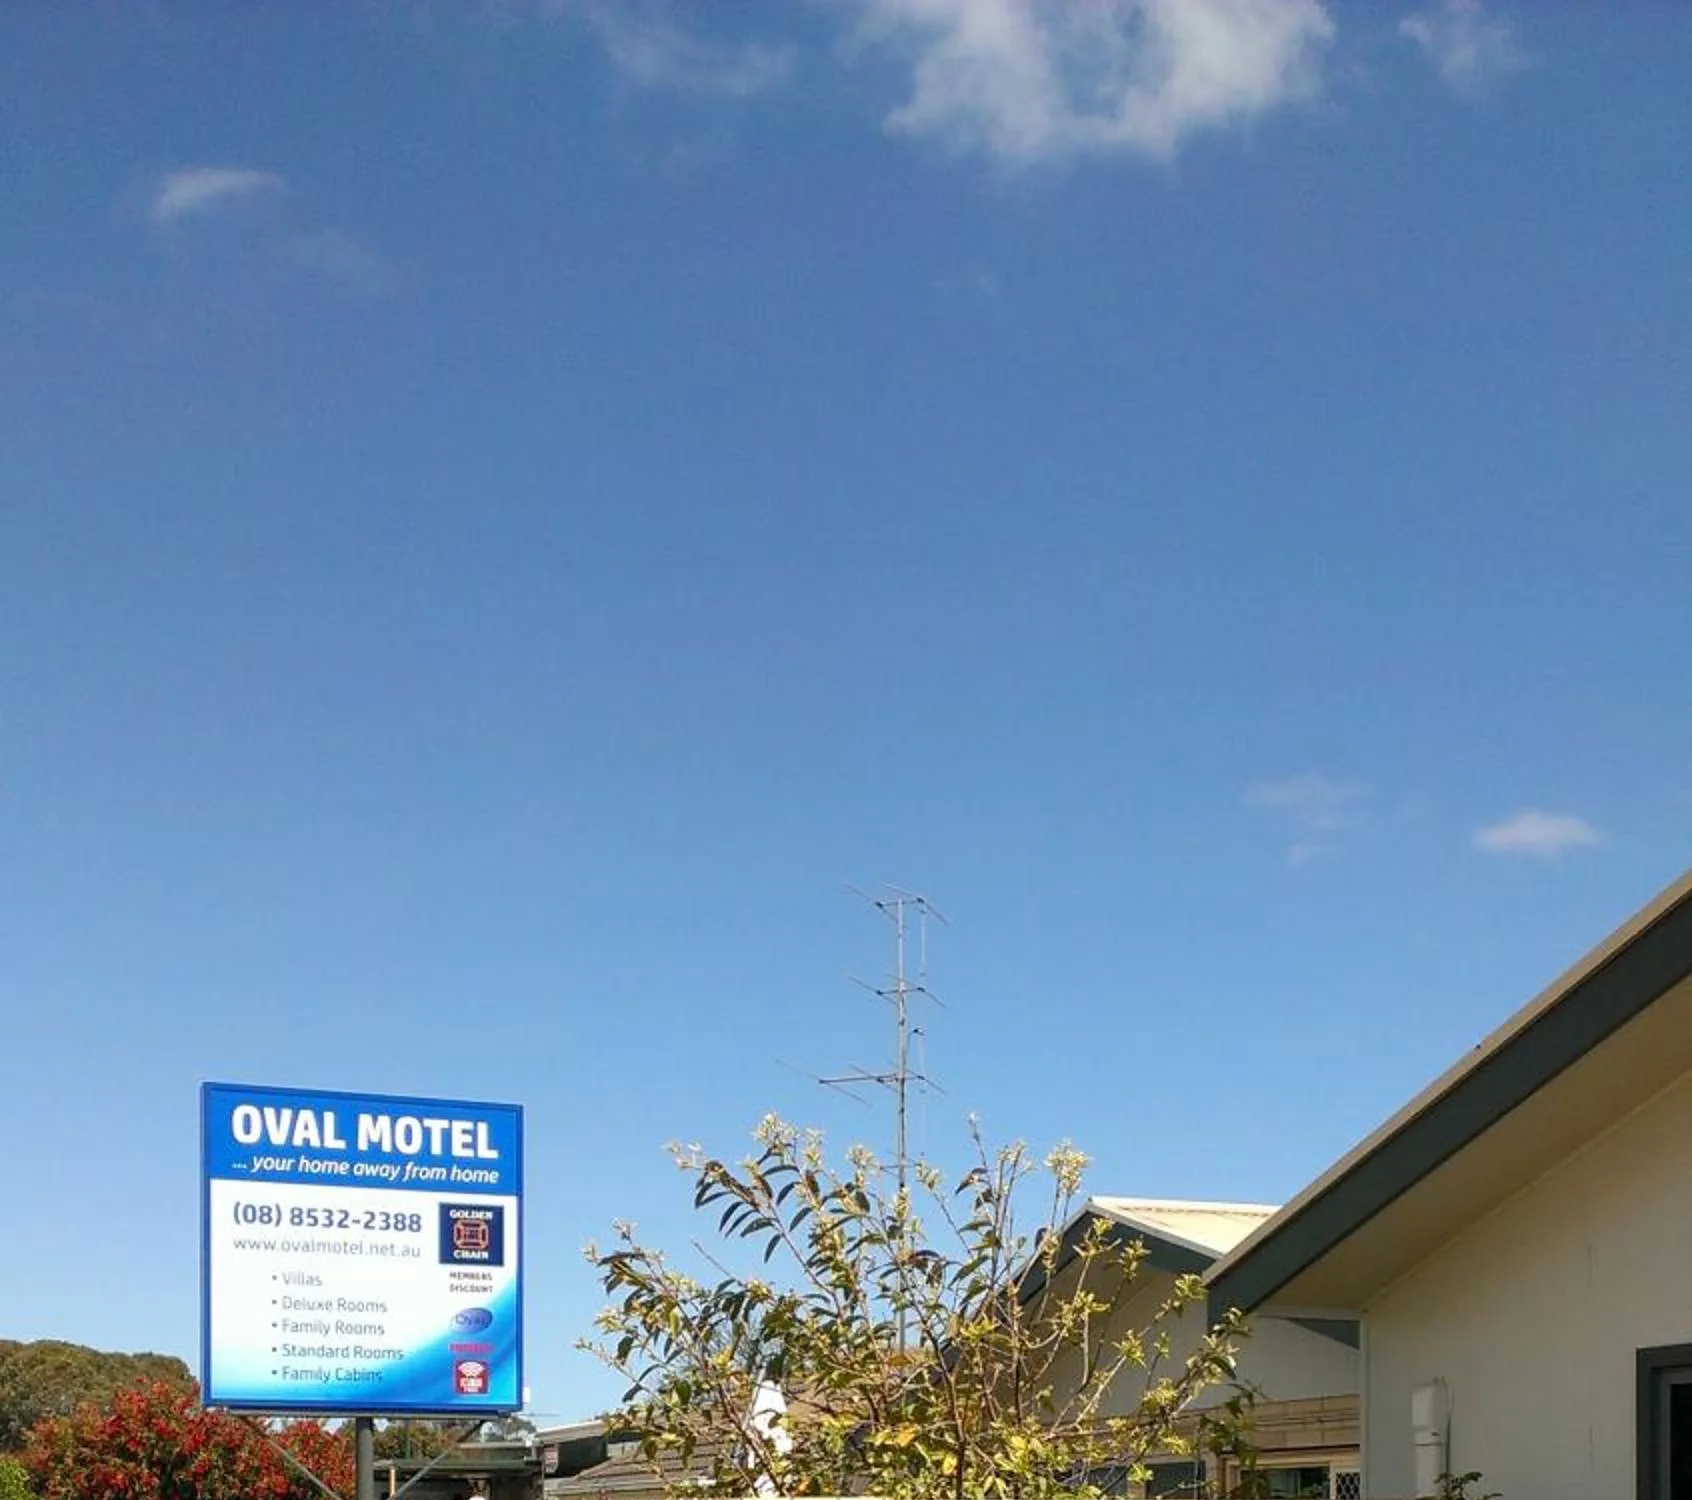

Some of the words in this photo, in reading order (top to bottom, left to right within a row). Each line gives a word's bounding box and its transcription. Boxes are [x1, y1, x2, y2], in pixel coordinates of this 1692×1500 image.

[231, 1104, 346, 1149] OVAL
[357, 1113, 499, 1160] MOTEL
[251, 1155, 297, 1173] your
[298, 1156, 350, 1175] home
[353, 1162, 400, 1182] away
[401, 1162, 447, 1182] from
[451, 1166, 499, 1184] home
[233, 1201, 282, 1227] (08)
[289, 1206, 422, 1233] 8532-2388
[449, 1209, 494, 1219] GOLDEN
[233, 1237, 422, 1258] www.ovalmotel.net.au
[453, 1249, 489, 1260] CHAIN
[282, 1270, 323, 1287] Villas
[449, 1271, 493, 1281] MEMBERS
[282, 1295, 333, 1312] Deluxe
[337, 1297, 388, 1313] Rooms
[282, 1318, 330, 1336] Family
[335, 1319, 385, 1336] Rooms
[282, 1343, 350, 1359] Standard
[353, 1345, 404, 1361] Rooms
[282, 1365, 330, 1384] Family
[335, 1367, 384, 1382] Cabins
